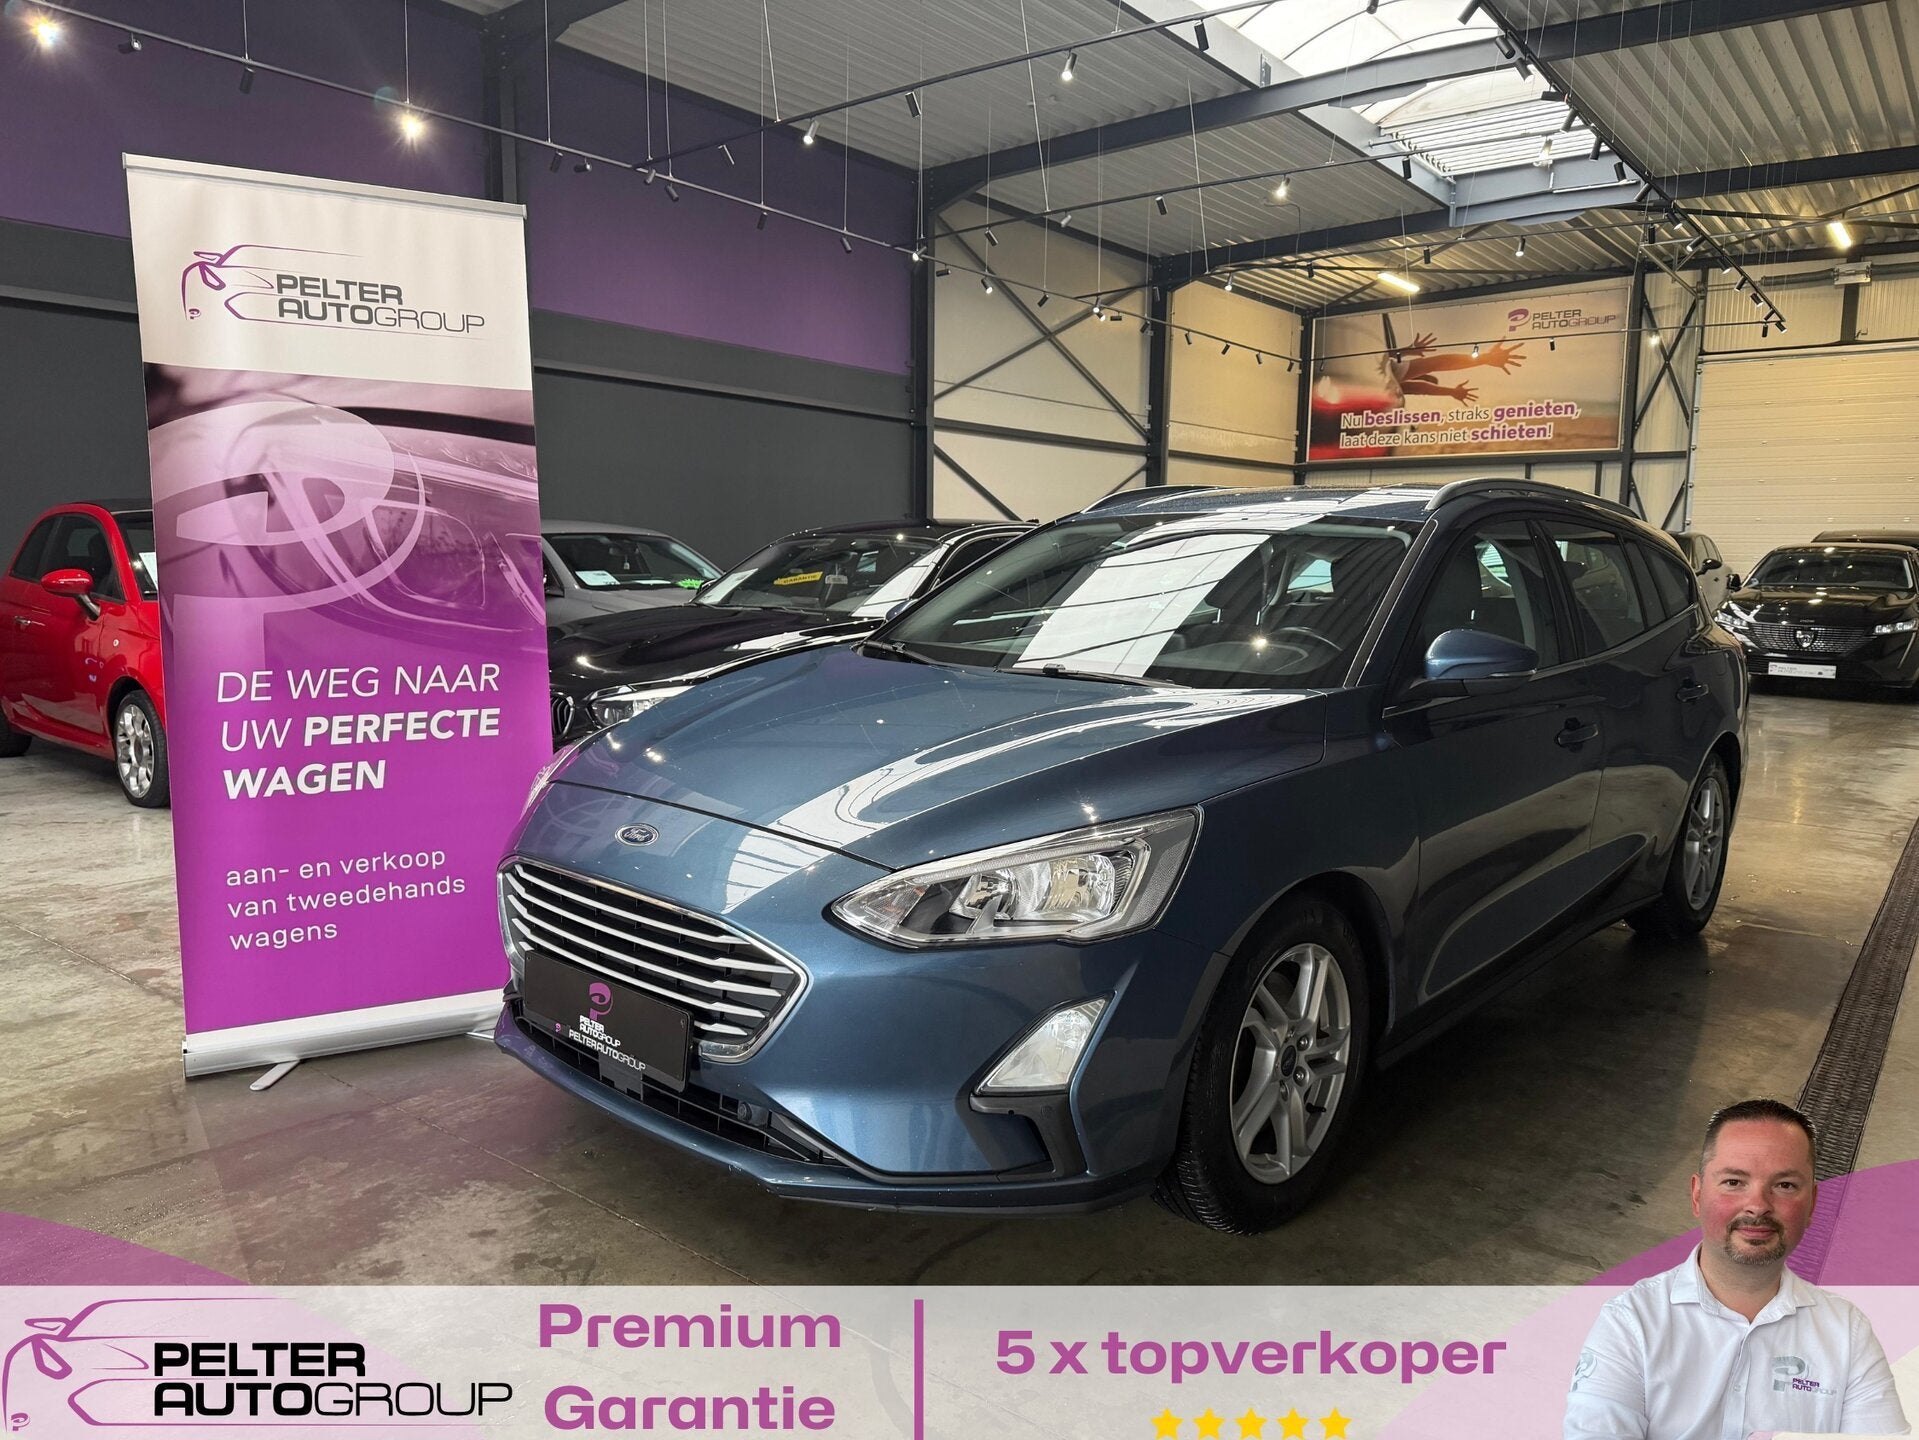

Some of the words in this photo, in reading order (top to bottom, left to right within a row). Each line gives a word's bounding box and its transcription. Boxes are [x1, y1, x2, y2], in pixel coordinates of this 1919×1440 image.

[276, 274, 403, 305] PELTER
[278, 298, 485, 333] AUTOGROUP
[1532, 309, 1582, 321] PELTER
[1532, 315, 1616, 330] AUTOGROUP
[1342, 413, 1361, 428] Nu
[1364, 410, 1446, 426] beslissen,
[1448, 406, 1489, 421] straks
[1494, 402, 1580, 422] genieten,
[1340, 432, 1365, 447] laat
[1368, 431, 1400, 445] deze
[1404, 429, 1436, 444] kans
[1440, 427, 1468, 442] niet
[1471, 424, 1552, 441] schieten!
[217, 670, 273, 703] DE
[286, 666, 380, 700] WEG
[394, 663, 500, 696] NAAR
[221, 717, 292, 752] UW
[304, 707, 501, 747] PERFECTE
[223, 759, 386, 800] WAGEN
[226, 865, 290, 887] aan-
[299, 858, 331, 879] en
[340, 850, 446, 876] verkoop
[228, 897, 277, 919] van
[288, 876, 466, 912] tweedehands
[229, 922, 338, 951] wagens
[579, 1015, 605, 1033] PELTER
[579, 1023, 621, 1047] AUTOGROUP
[1792, 1378, 1820, 1387] PELTER
